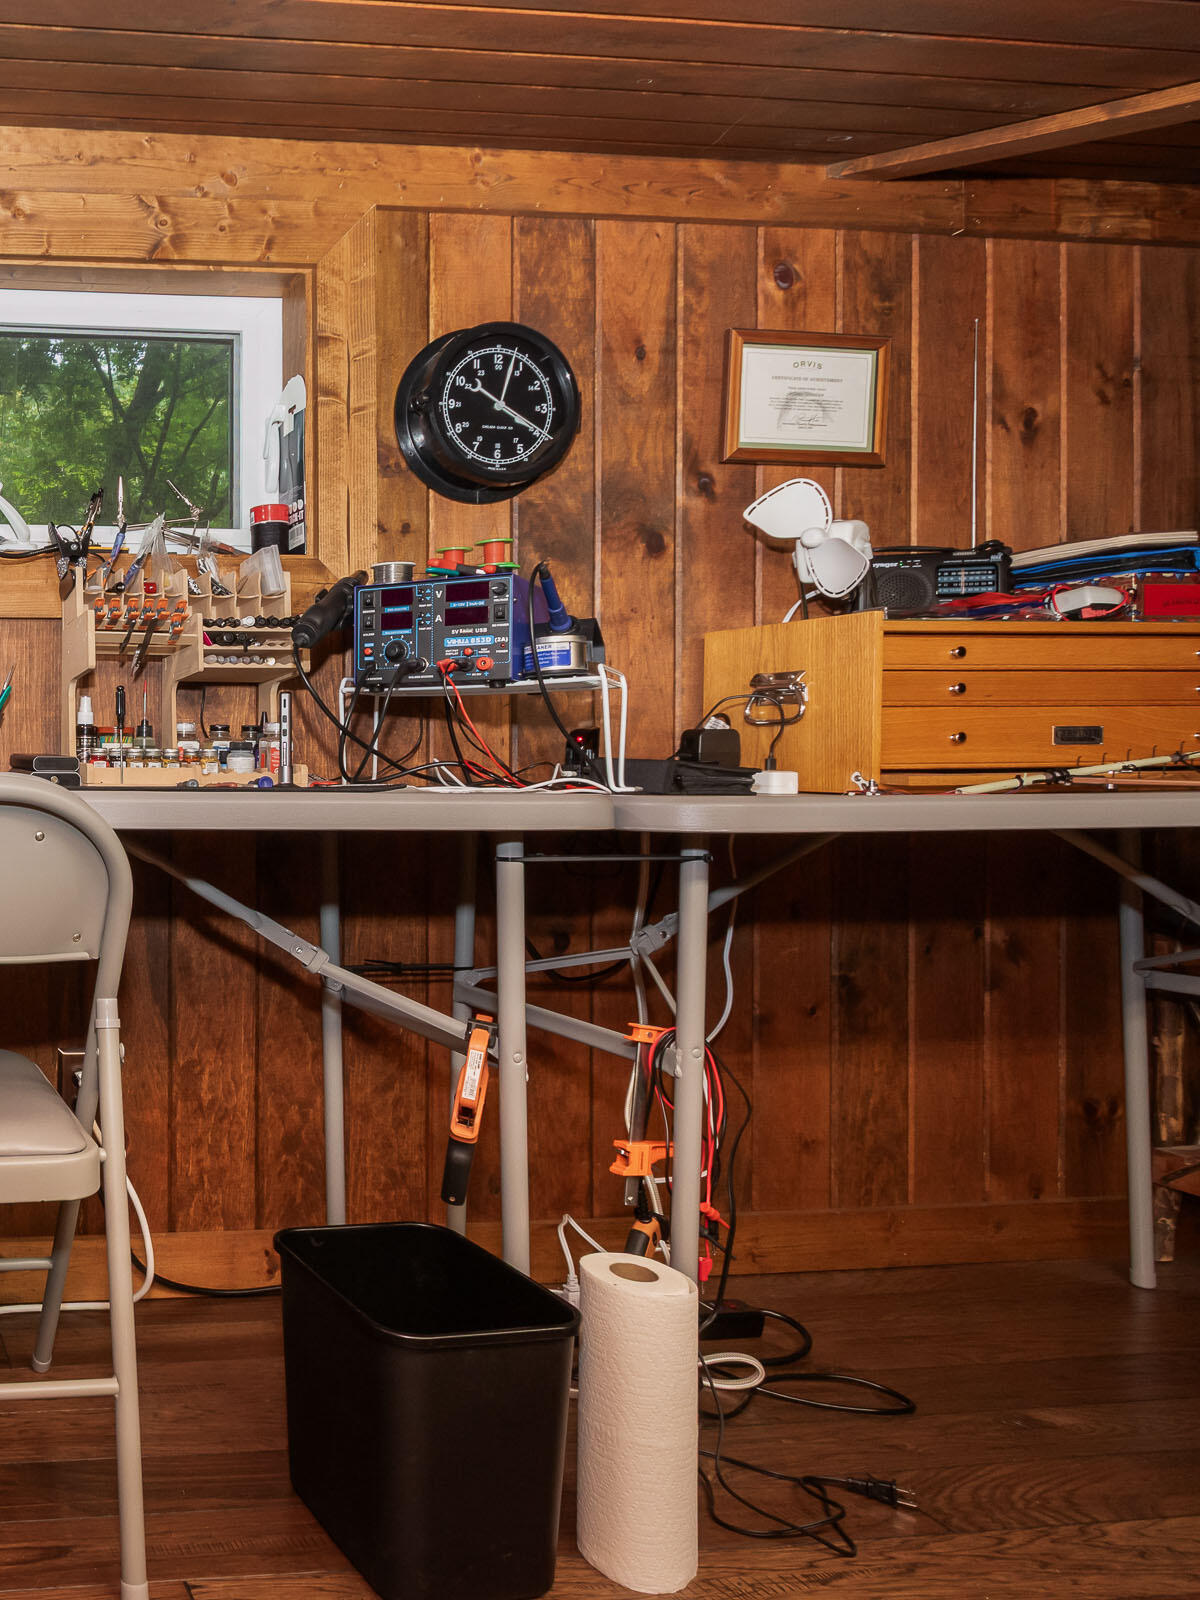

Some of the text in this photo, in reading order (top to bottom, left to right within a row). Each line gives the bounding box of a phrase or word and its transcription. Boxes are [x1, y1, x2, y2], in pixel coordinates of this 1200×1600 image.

[473, 359, 480, 369] 11
[494, 354, 503, 364] 12
[792, 360, 823, 369] ORVIS
[456, 375, 466, 386] 10
[533, 381, 541, 390] 2
[448, 399, 455, 408] 9
[540, 403, 548, 413] 3
[455, 423, 462, 433] 8
[472, 441, 480, 451] 7
[516, 444, 524, 454] 5
[494, 449, 501, 459] 6
[435, 590, 443, 598] V
[435, 614, 442, 622] A
